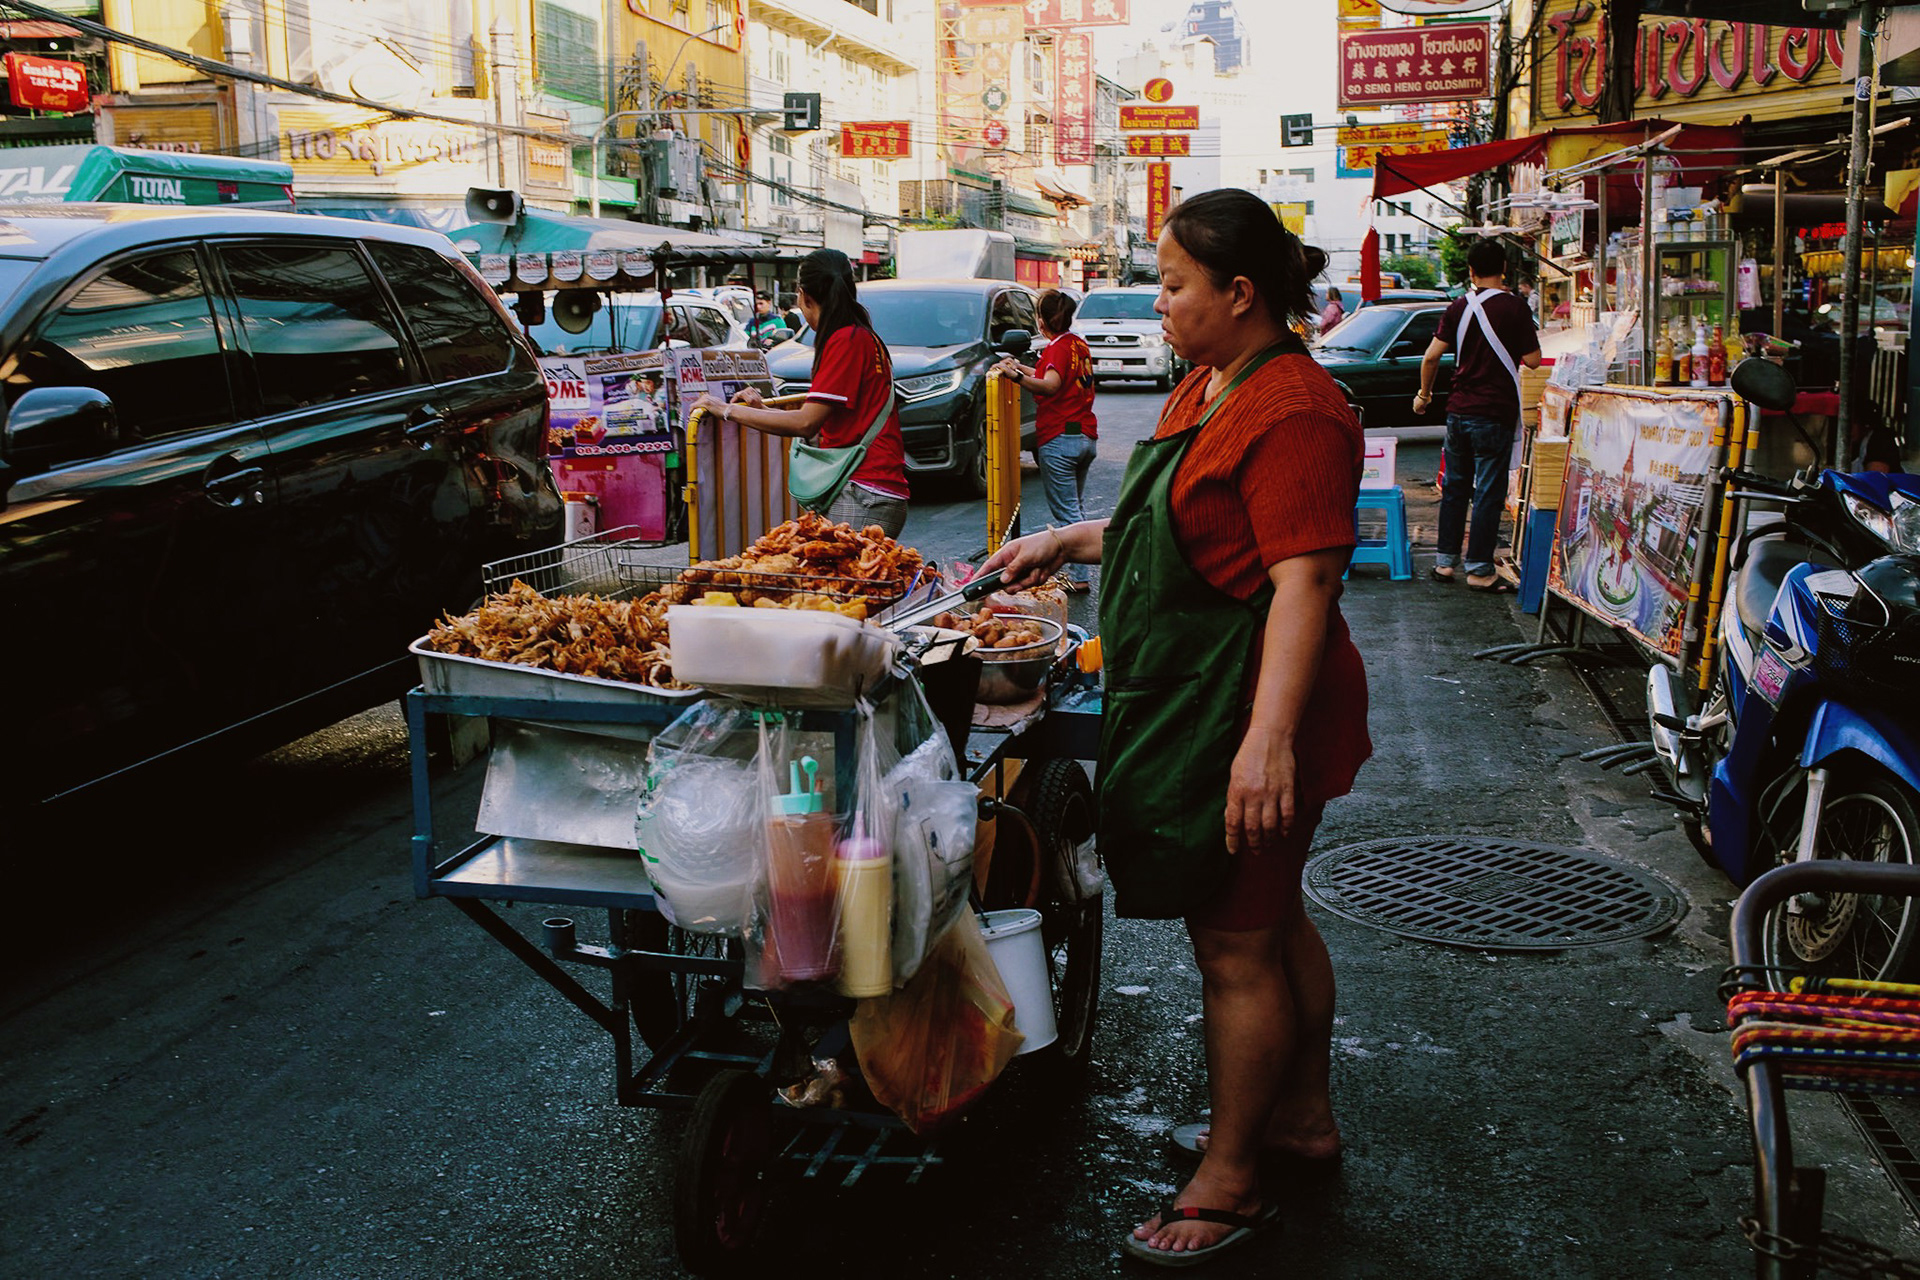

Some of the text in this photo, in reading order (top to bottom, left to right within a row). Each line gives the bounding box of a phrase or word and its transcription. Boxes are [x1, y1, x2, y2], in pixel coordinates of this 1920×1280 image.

[1347, 34, 1483, 60] ห้างขายทอง โซวเซ่งเฮง
[1347, 78, 1483, 95] SO SENG HENG GOLDSMITH
[1130, 136, 1185, 155] 中國城
[130, 176, 187, 200] TOTAL
[519, 262, 544, 271] HOME
[554, 259, 579, 268] HOME
[680, 366, 705, 383] HOME
[549, 380, 587, 399] OME
[575, 440, 674, 456] 082-698-9295
